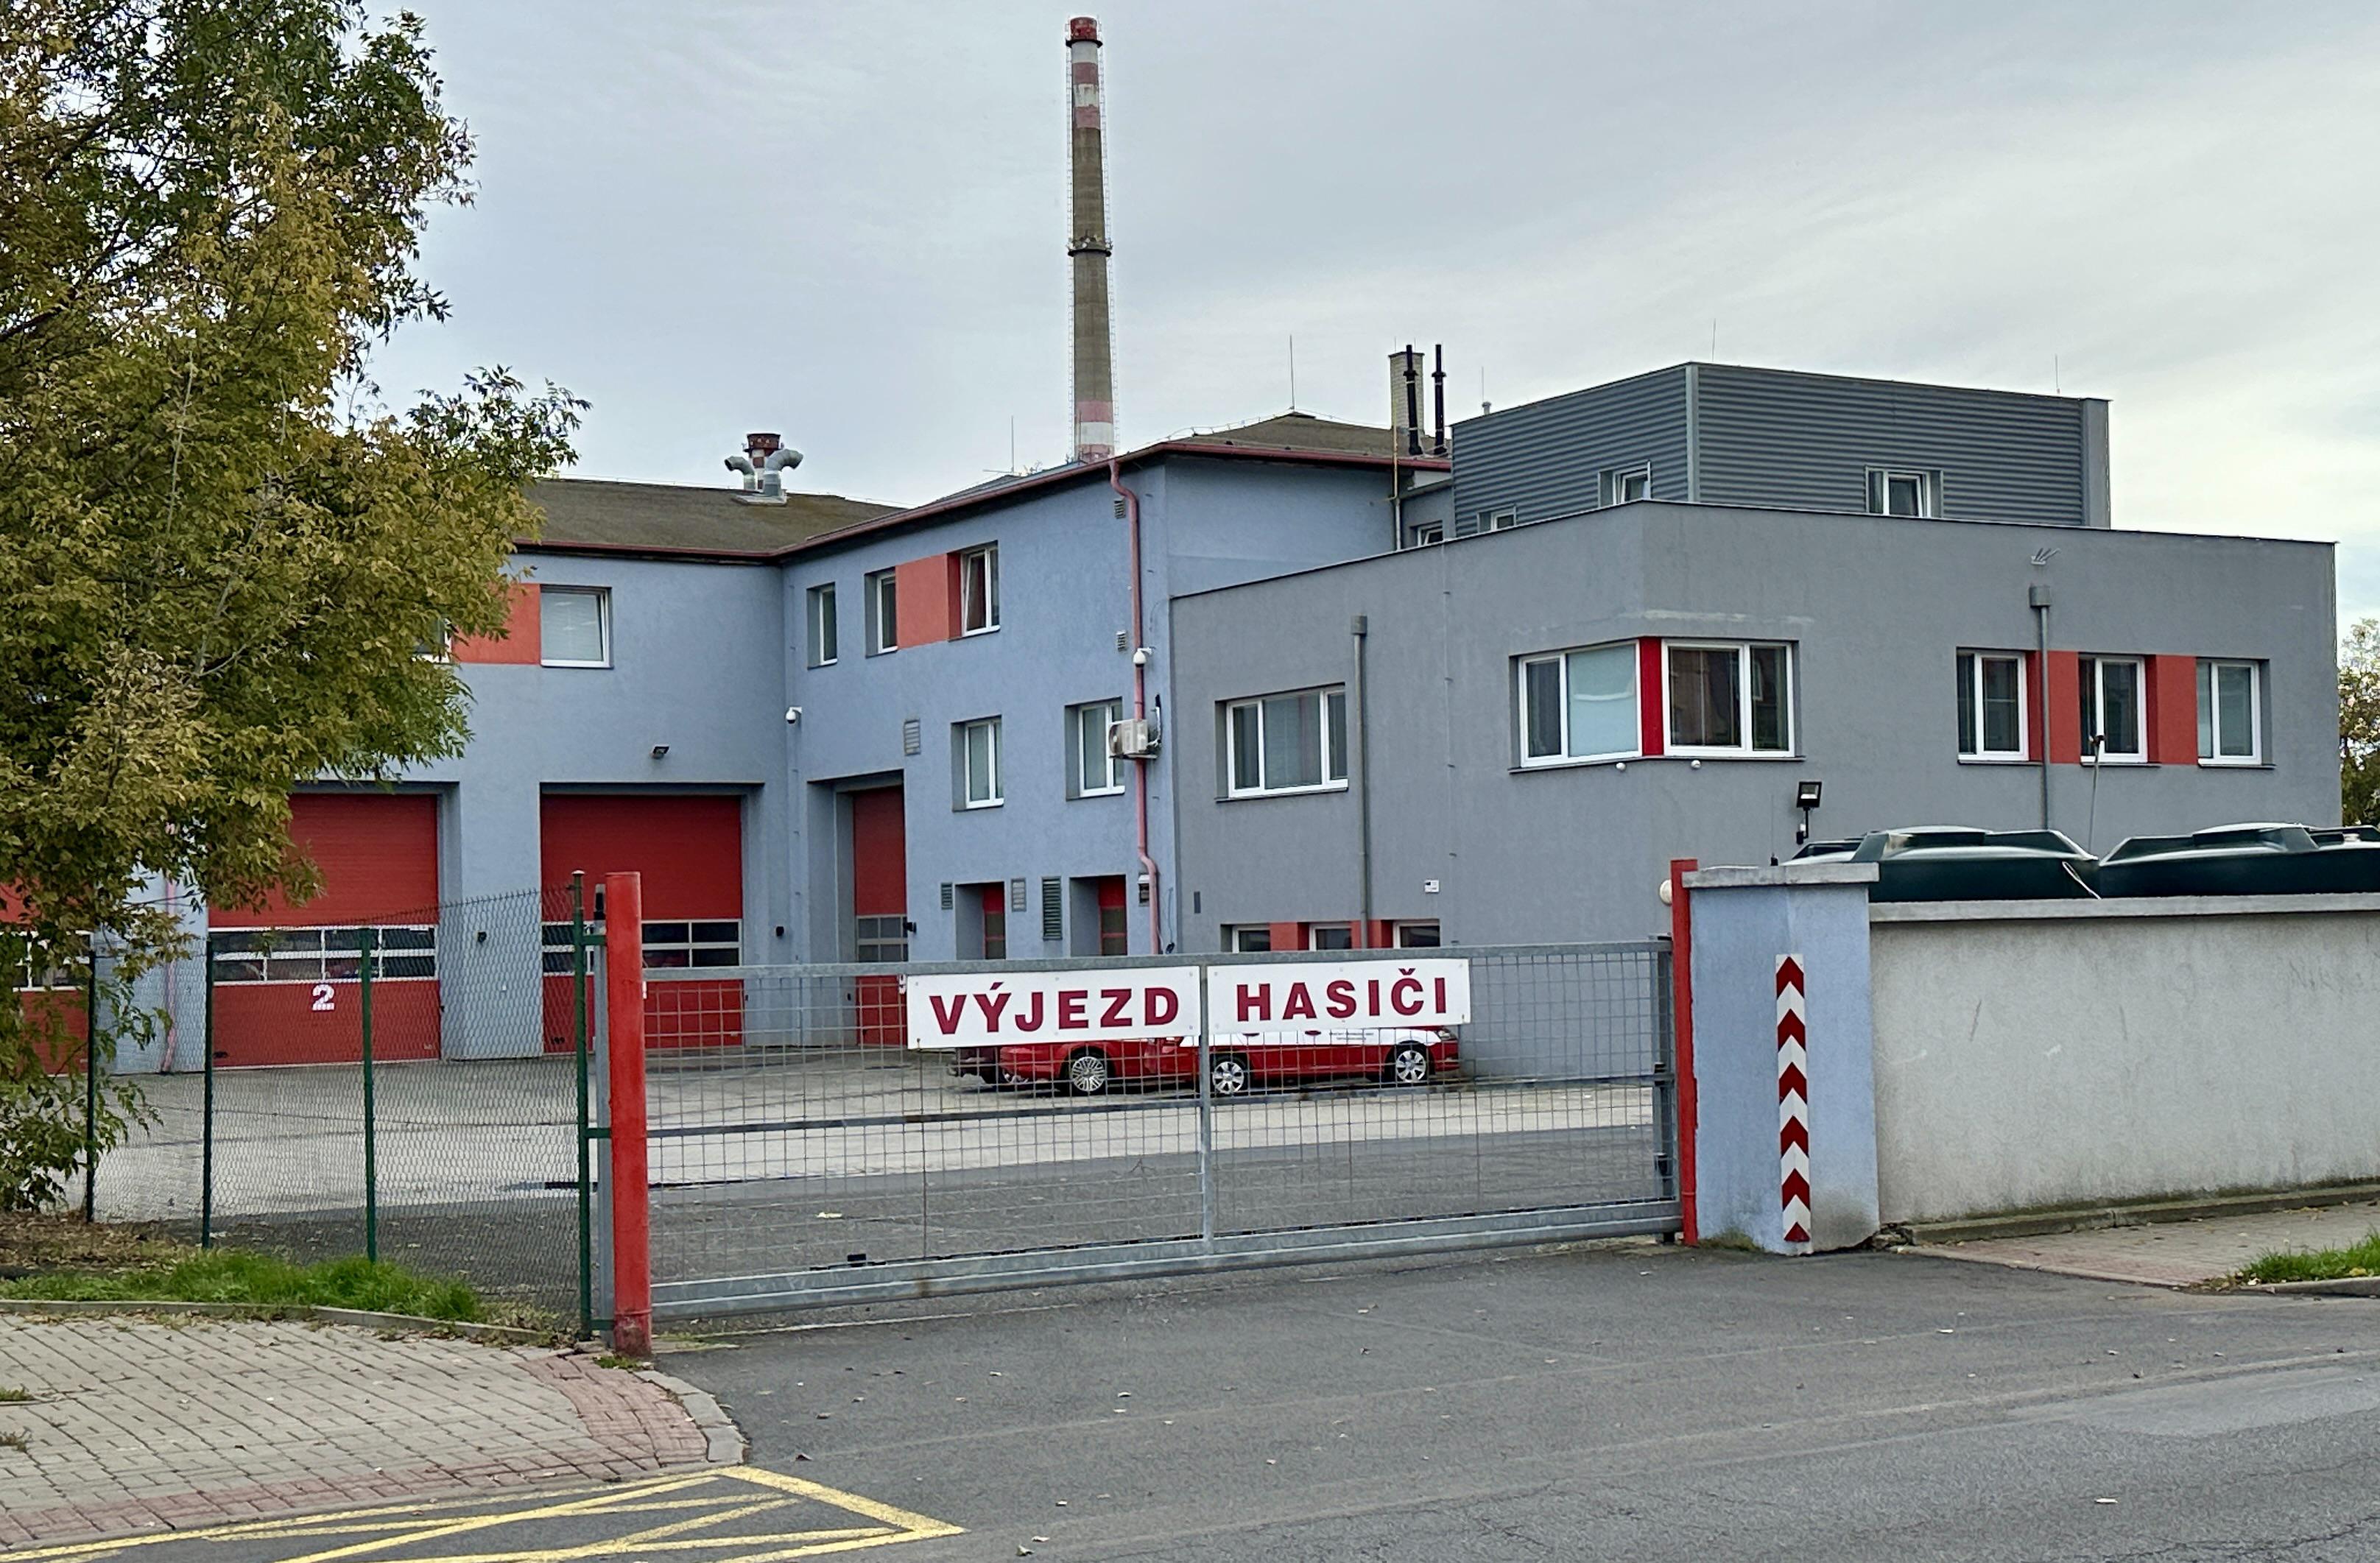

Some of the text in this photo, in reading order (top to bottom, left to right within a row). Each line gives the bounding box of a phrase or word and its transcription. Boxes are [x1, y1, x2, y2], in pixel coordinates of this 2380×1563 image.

[312, 984, 335, 1011] 2
[930, 968, 1446, 1034] VÝJEZD HASIČI
